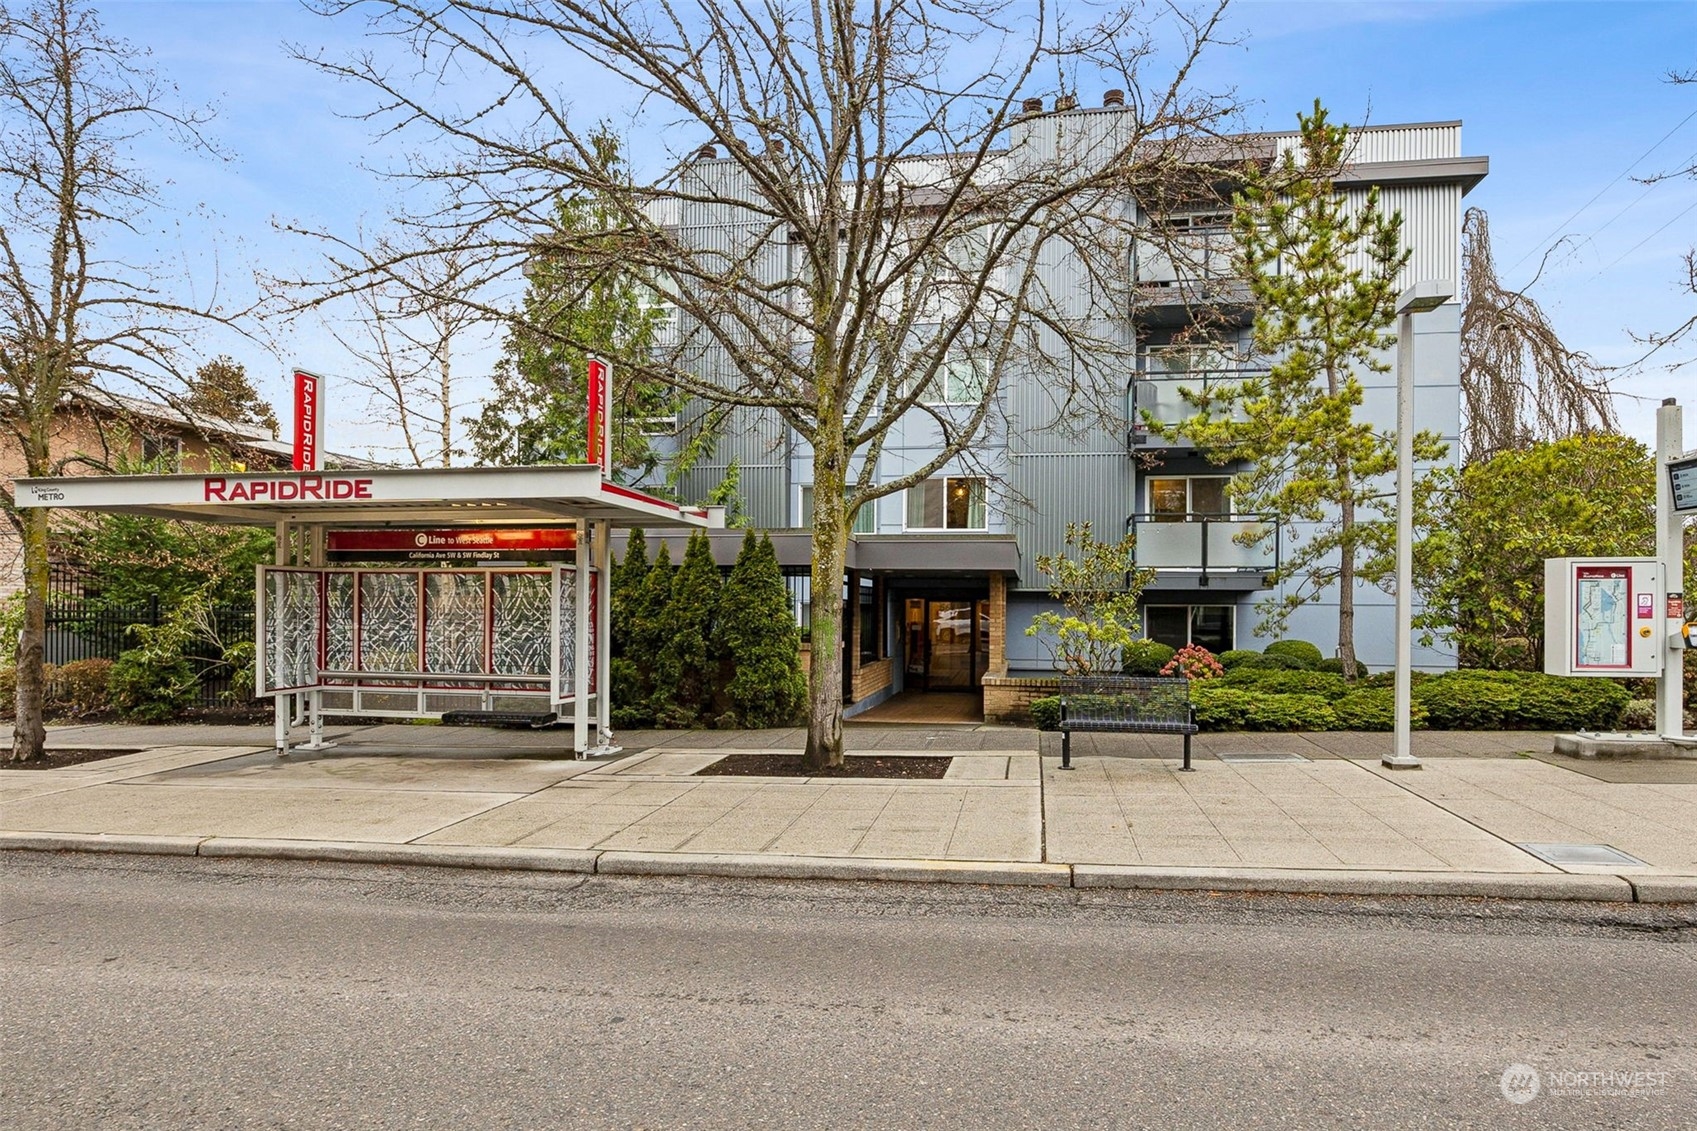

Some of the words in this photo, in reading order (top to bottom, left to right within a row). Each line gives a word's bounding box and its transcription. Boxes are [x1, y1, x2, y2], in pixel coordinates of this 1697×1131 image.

[38, 493, 65, 501] METRO
[429, 535, 445, 544] Line
[473, 552, 492, 560] Findlay
